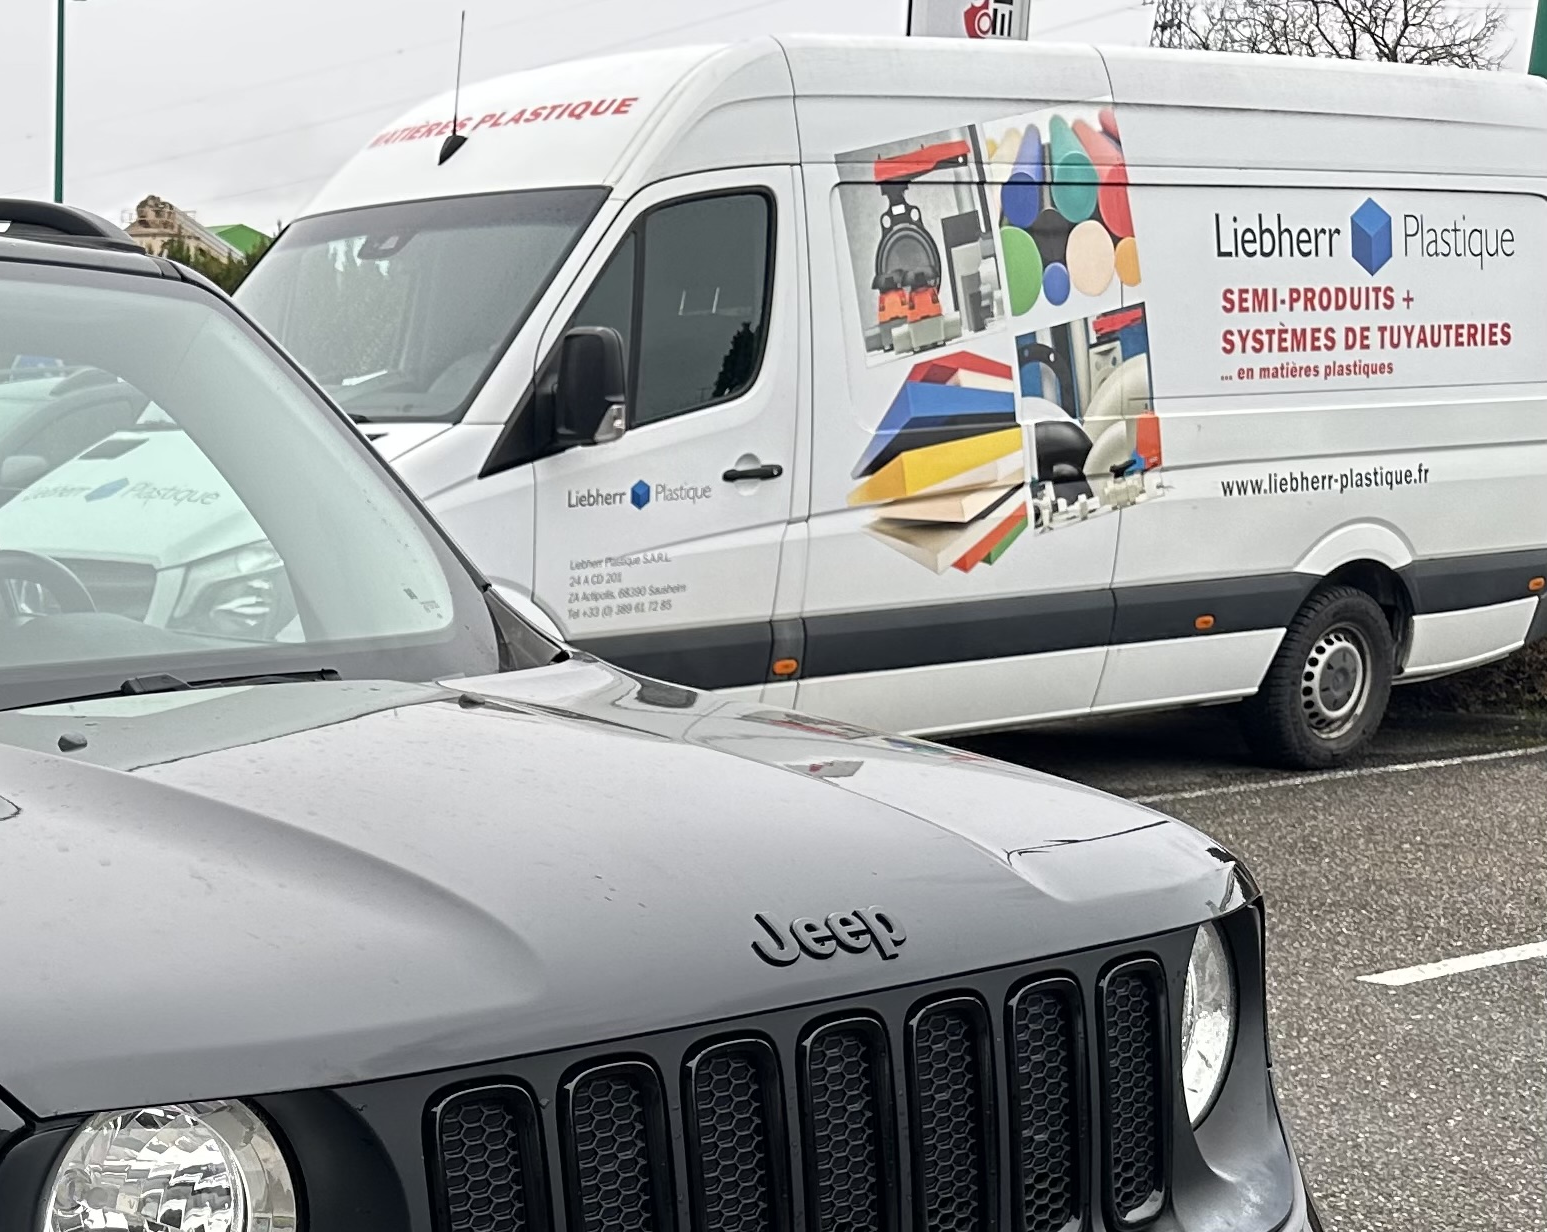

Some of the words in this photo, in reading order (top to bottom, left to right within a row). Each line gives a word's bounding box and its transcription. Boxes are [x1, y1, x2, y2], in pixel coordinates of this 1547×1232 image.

[472, 97, 640, 131] PLASTIQUE
[1215, 213, 1341, 258] Liebherr
[1403, 214, 1515, 270] Plastique
[1221, 286, 1395, 313] SEMI-PRODUITS
[1221, 322, 1337, 355] SYSTÈMES
[1344, 326, 1371, 351] DE
[1377, 322, 1512, 349] TUYAUTERIES
[1237, 364, 1254, 380] en
[1259, 360, 1320, 380] matières
[1324, 359, 1394, 384] plastiques
[567, 489, 626, 508] Liebherr
[655, 482, 712, 505] Plastique
[1221, 464, 1430, 497] www.liebherr-plastique.fr
[751, 904, 907, 967] Jeep
